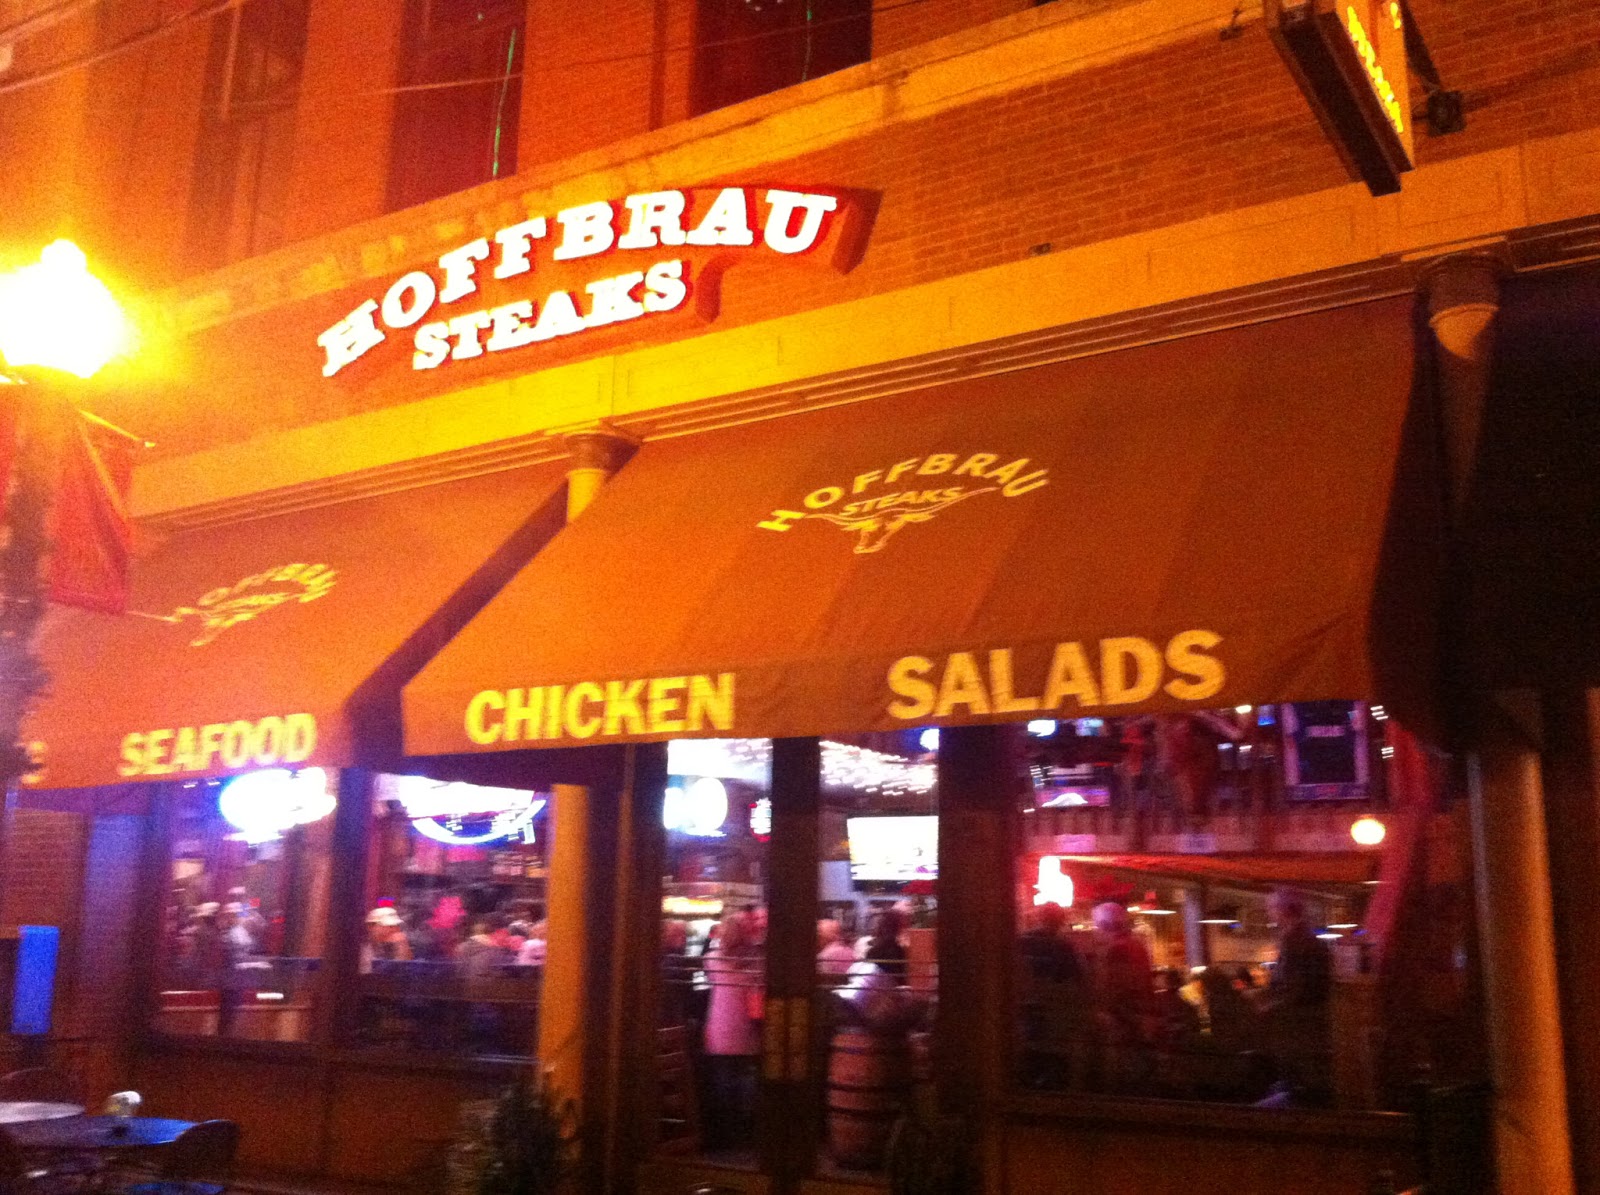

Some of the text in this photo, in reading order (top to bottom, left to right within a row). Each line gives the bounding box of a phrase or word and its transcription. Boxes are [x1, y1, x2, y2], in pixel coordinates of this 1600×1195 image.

[318, 188, 837, 377] HOFFBRAU
[413, 260, 686, 370] STEAKS
[757, 453, 1049, 531] HOFFBRAU
[840, 486, 963, 516] STEAKS
[464, 672, 736, 745] CHICKEN
[887, 629, 1225, 720] SALADS
[119, 713, 317, 777] SEAFOOD
